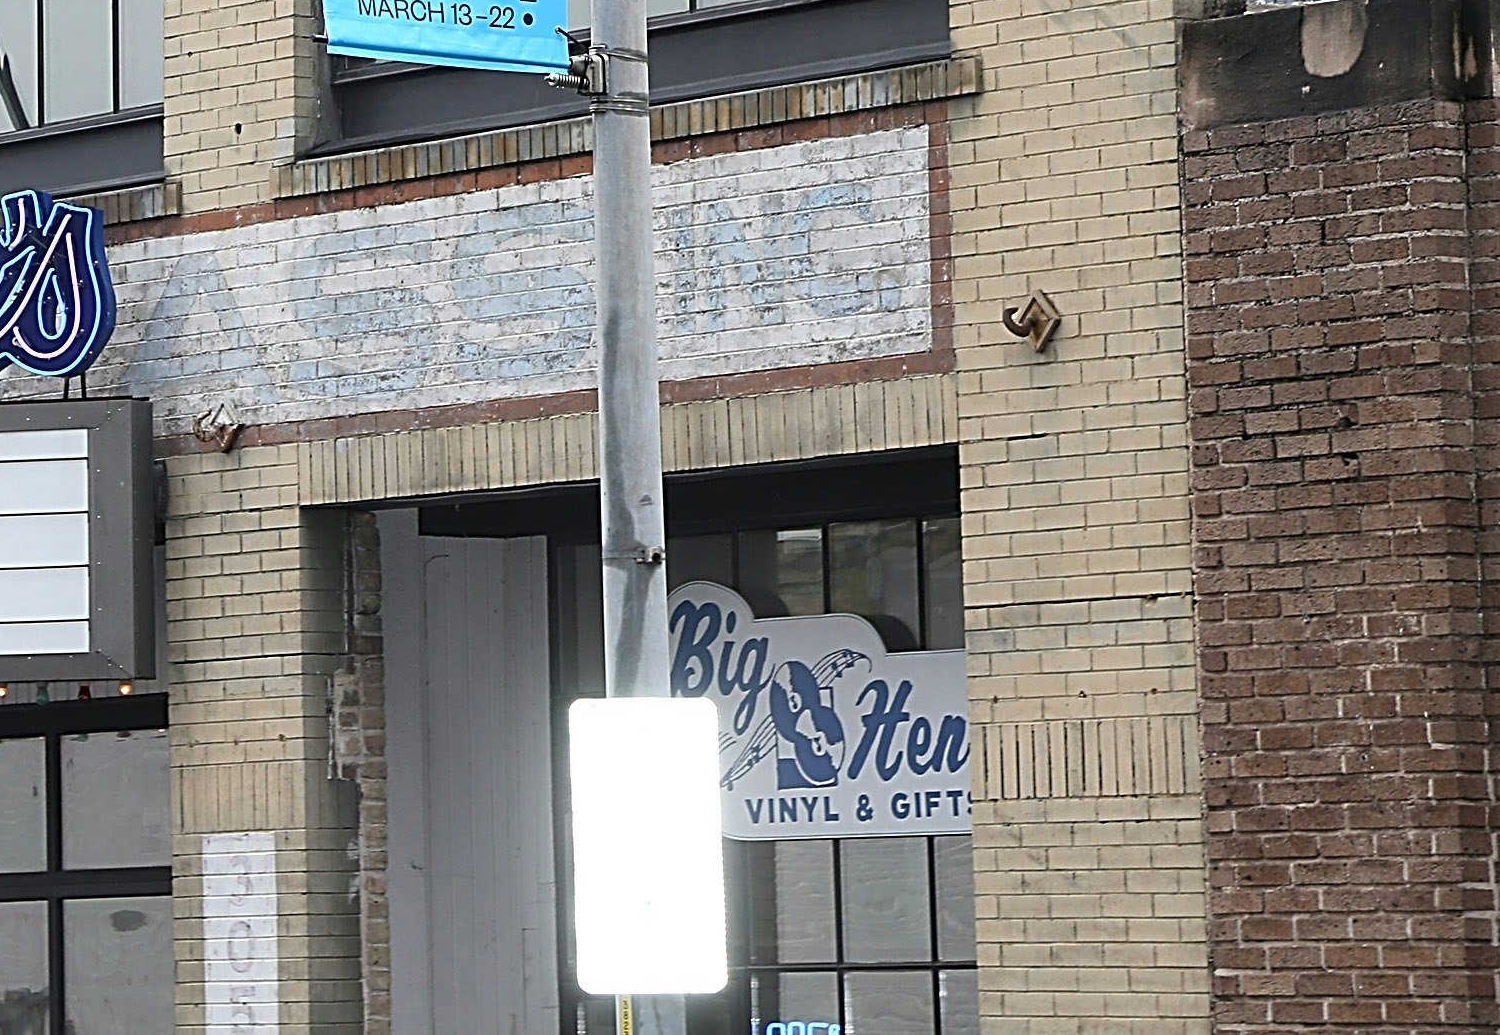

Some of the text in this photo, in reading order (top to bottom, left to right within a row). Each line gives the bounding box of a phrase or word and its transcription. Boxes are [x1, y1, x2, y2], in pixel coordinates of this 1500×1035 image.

[669, 598, 775, 736] Big
[745, 795, 840, 825] VINYL
[856, 794, 873, 823] &
